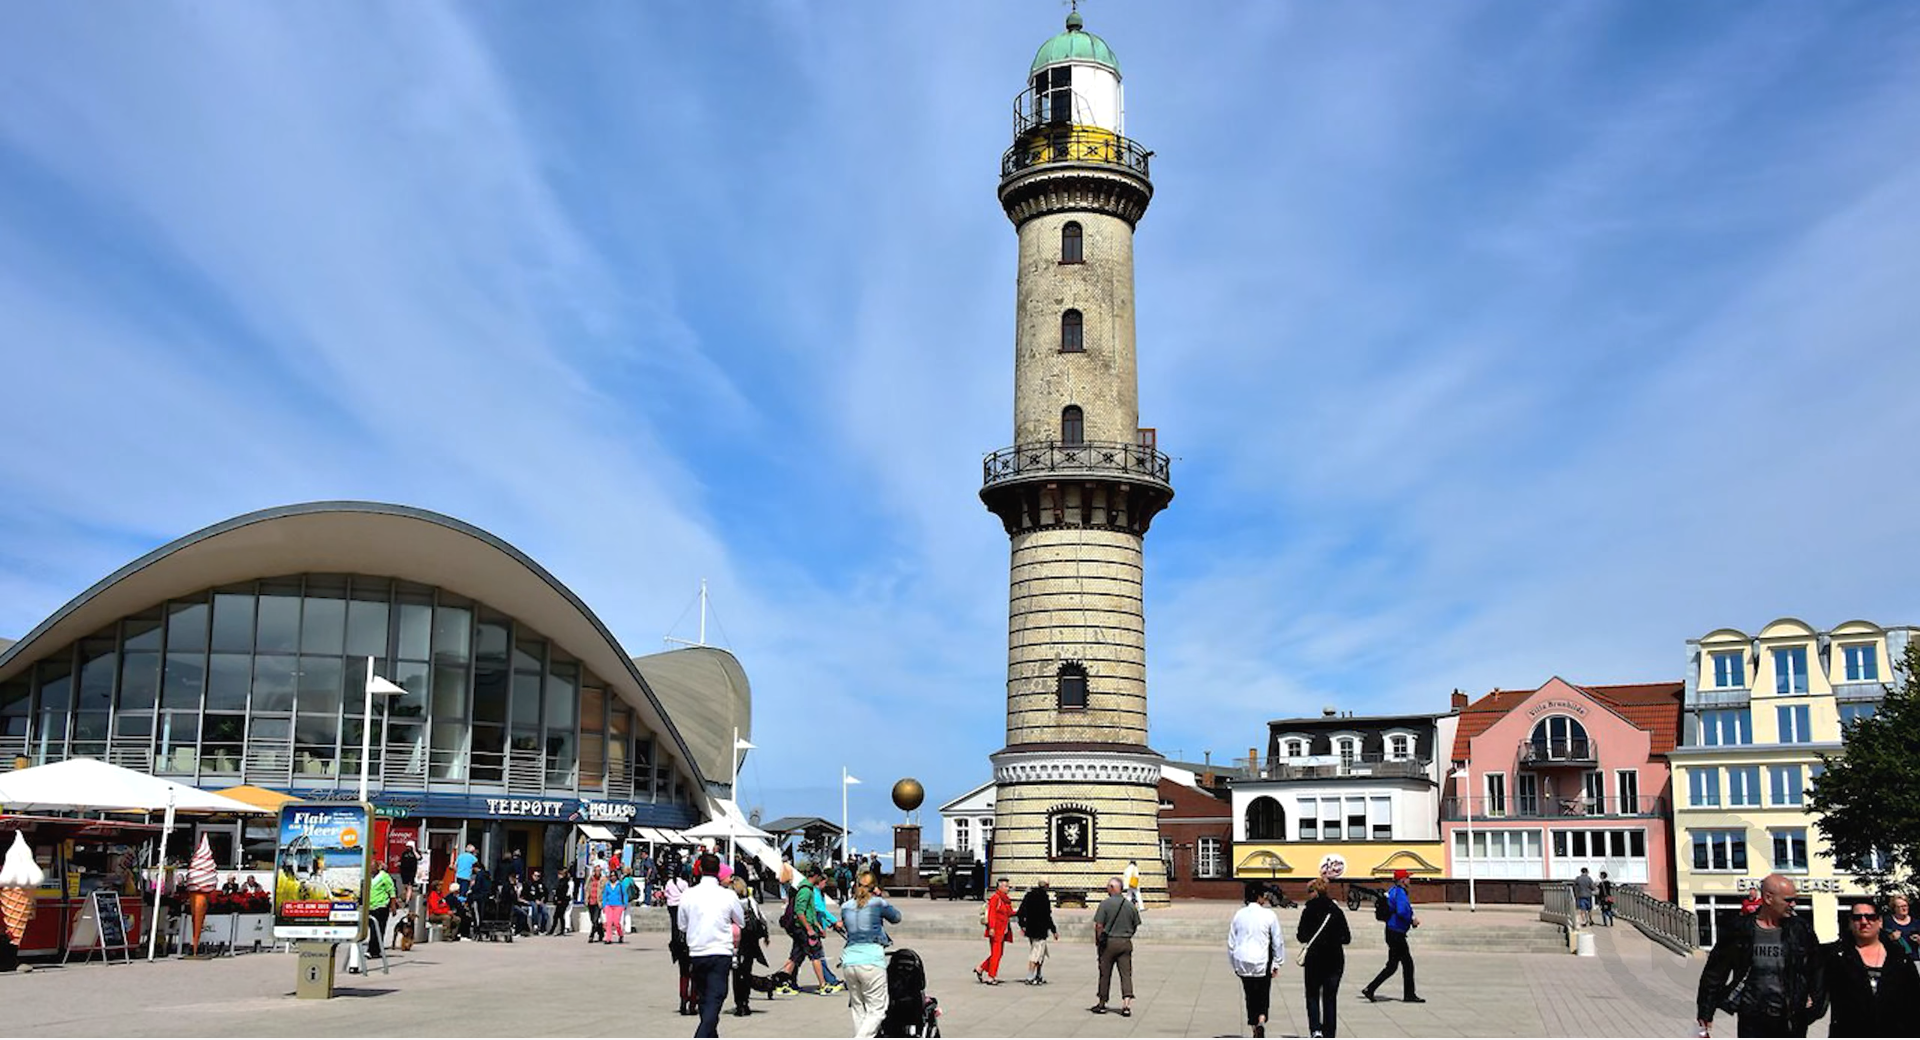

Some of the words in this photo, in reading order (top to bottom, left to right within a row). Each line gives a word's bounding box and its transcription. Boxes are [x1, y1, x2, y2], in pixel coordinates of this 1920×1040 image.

[486, 799, 563, 816] TEEPOTT
[294, 812, 332, 825] Flair
[301, 824, 339, 836] Meer
